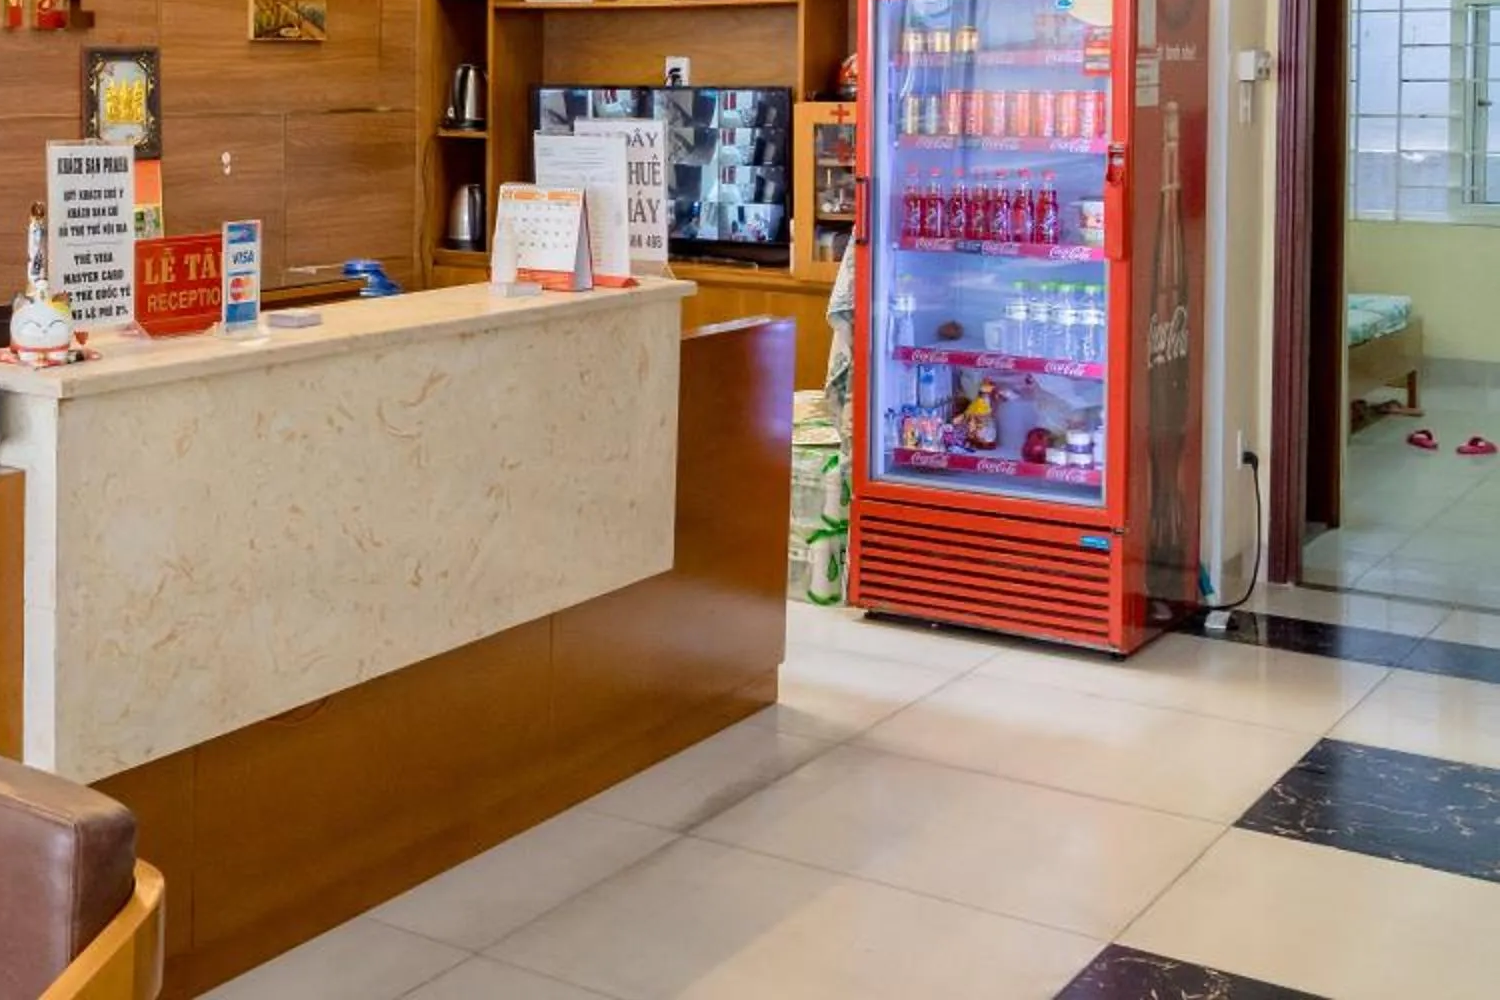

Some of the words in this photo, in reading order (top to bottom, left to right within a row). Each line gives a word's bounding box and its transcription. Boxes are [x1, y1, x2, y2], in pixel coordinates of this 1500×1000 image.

[627, 127, 658, 147] ÂY
[627, 153, 662, 186] HUÊ
[183, 247, 222, 281] TÂ
[232, 249, 255, 265] VISA
[63, 271, 99, 285] MASTER
[101, 269, 124, 281] CARD
[147, 286, 221, 314] RECEPTIO
